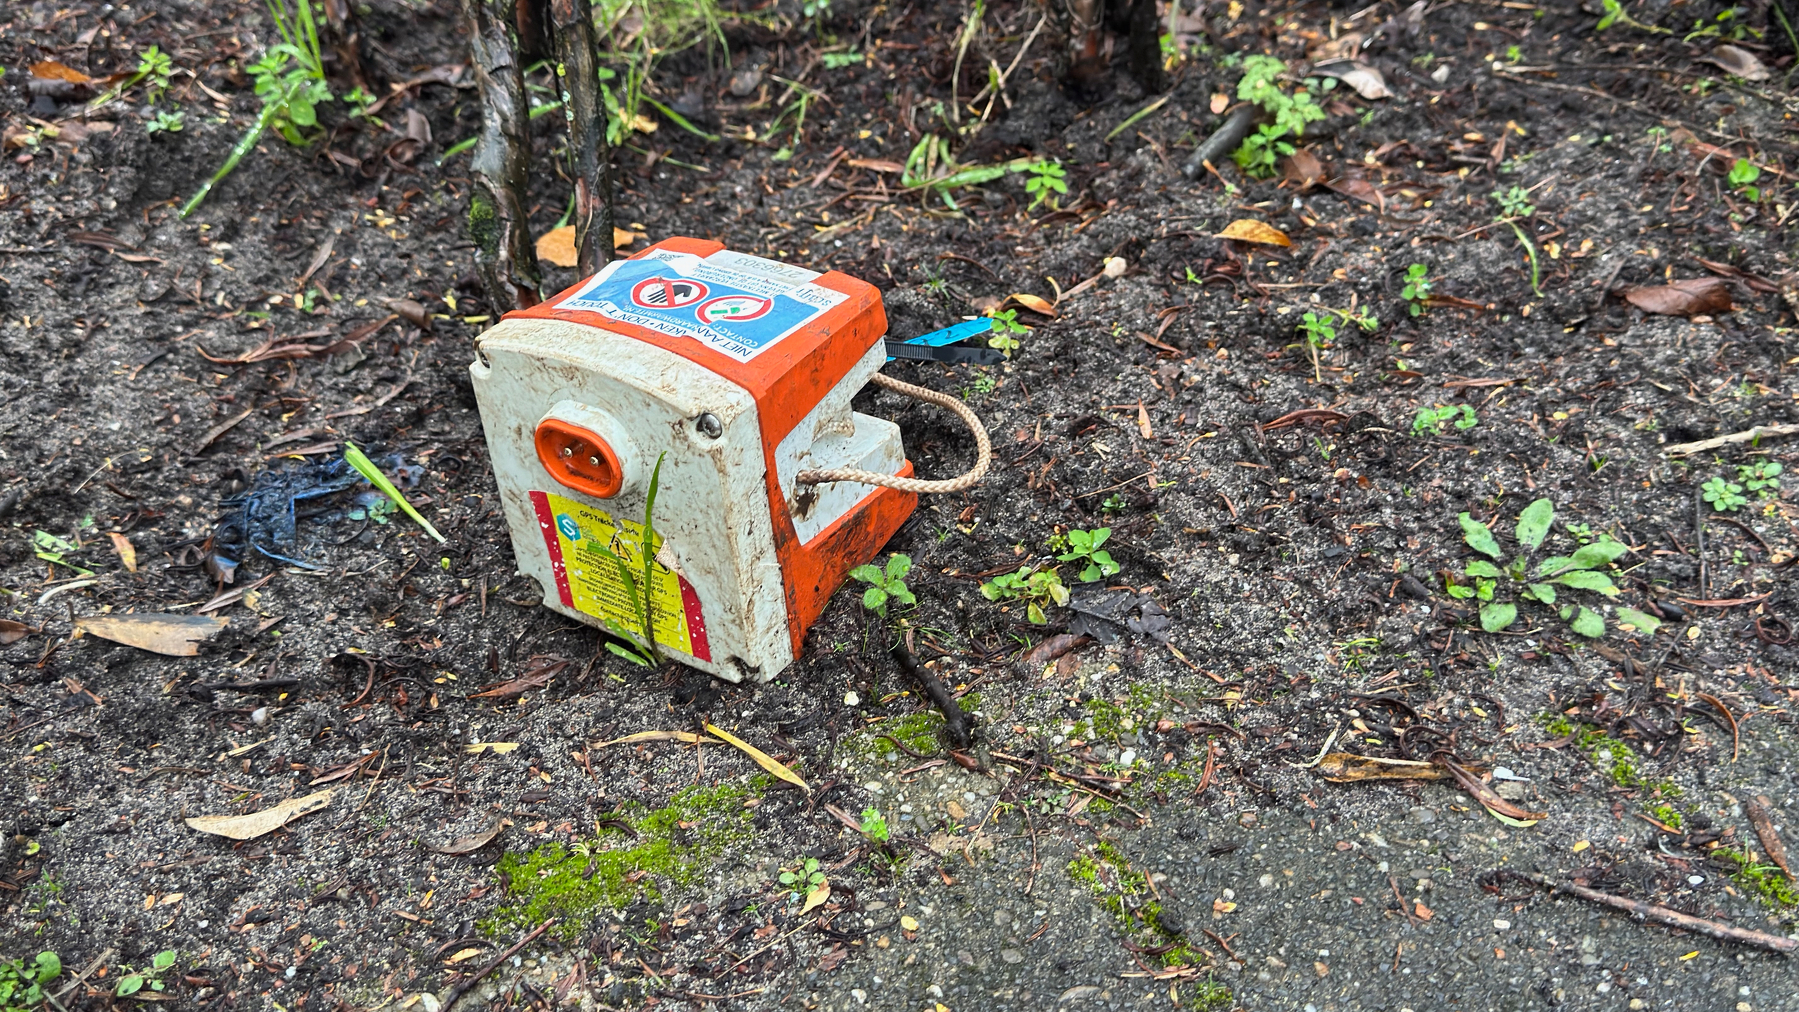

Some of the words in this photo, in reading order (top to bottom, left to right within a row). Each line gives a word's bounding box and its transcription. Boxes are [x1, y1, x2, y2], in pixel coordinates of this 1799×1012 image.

[565, 300, 609, 310] TOUCH
[604, 308, 650, 326] DON'T
[712, 323, 759, 347] CONTACT:
[718, 341, 753, 357] NIET
